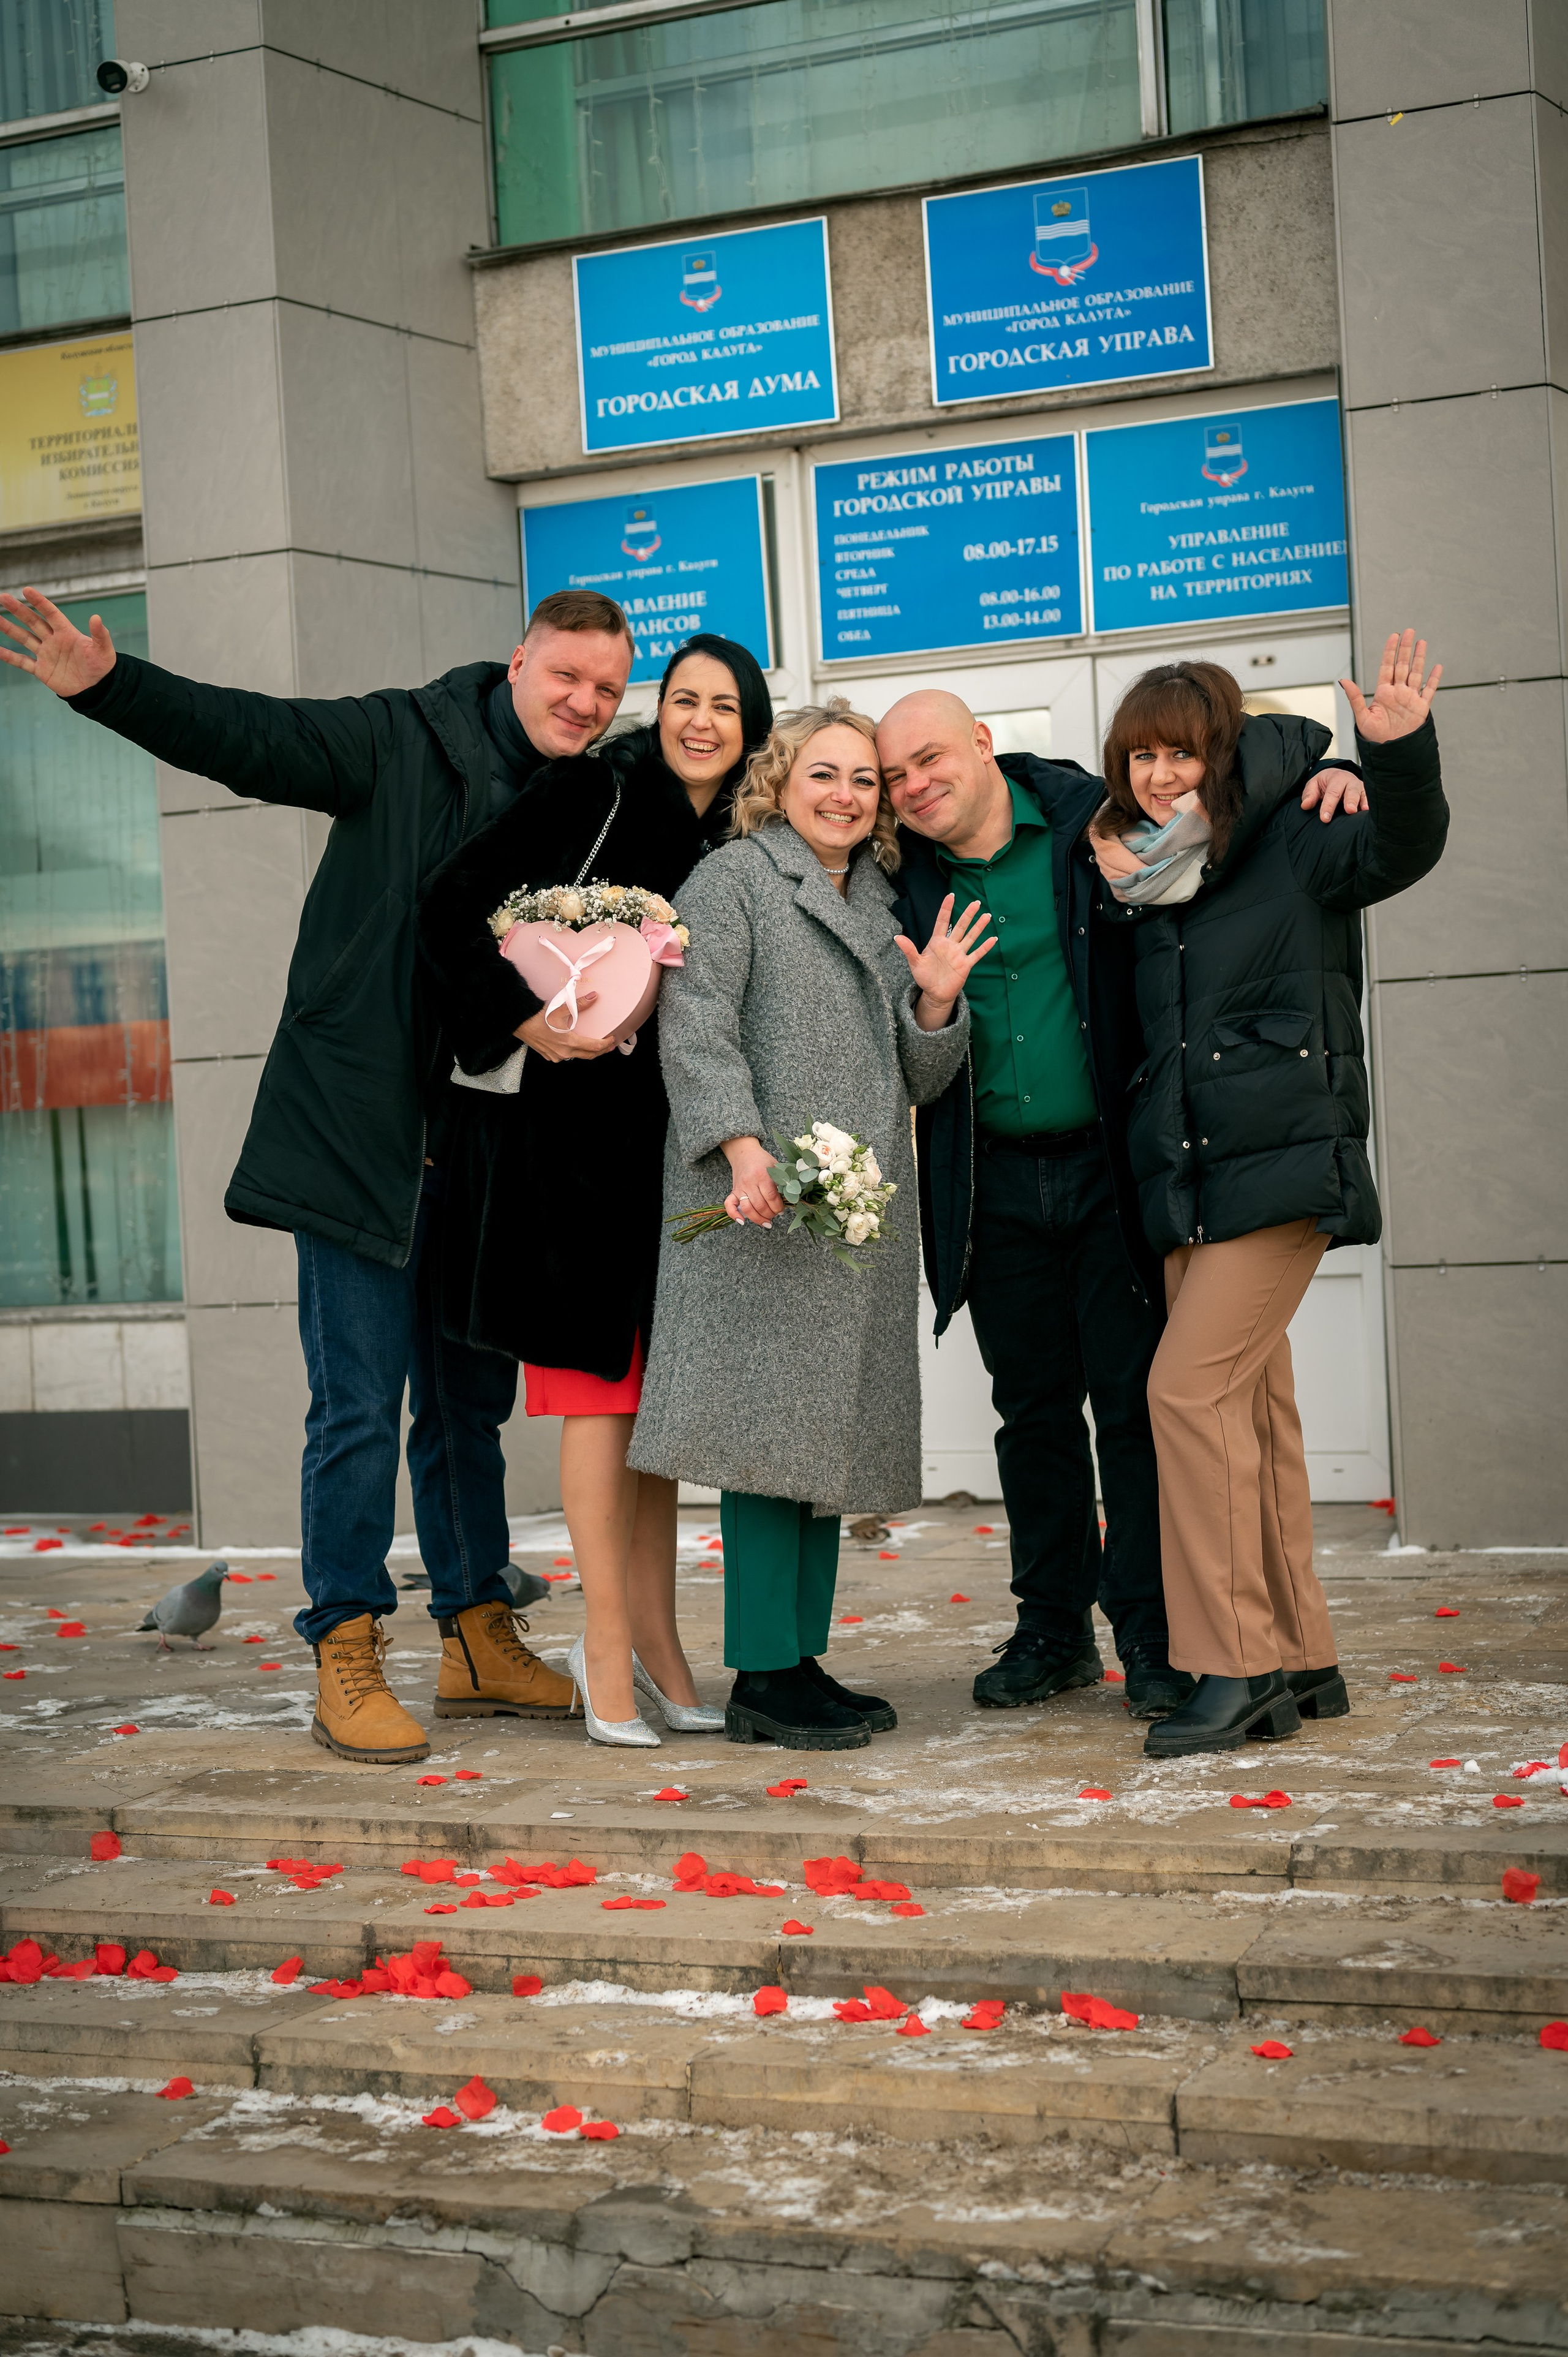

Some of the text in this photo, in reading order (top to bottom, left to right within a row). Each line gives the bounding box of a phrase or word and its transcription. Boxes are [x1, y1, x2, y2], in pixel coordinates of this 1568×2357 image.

[943, 281, 1193, 326] МУНИЦИПАЛЬНОЕ ОБРАЗОВАНИЕ
[1006, 307, 1131, 333] «ГОРОД КАЛУГА»
[590, 315, 820, 357] МУНИЦИПАЛЬНОЕ ОБРАЗОВАНИЕ
[949, 325, 1194, 374] ГОРОДСКАЯ УПРАВА
[647, 342, 763, 367] «ГОРОД КАЛУГА»
[597, 371, 820, 417] ГОРОДСКАЯ ДУМА
[858, 454, 1034, 491] РЕЖИМ РАБОТЫ
[834, 475, 1061, 517] ГОРОДСКОЙ УПРАВЫ
[1140, 499, 1203, 515] Городская
[1208, 493, 1250, 508] управа
[1269, 485, 1314, 497] Калуги
[834, 526, 929, 545] ПОНЕДЕЛЬНИК
[963, 535, 1058, 561] 08.00-17.15
[1169, 522, 1288, 549] УПРАВЛЕНИЕ
[835, 548, 894, 563] ВТОРНИК
[1104, 540, 1348, 581] ПО РАБОТЕ С НАСЕЛЕНИЕ
[835, 568, 876, 581] СРЕДА
[1151, 570, 1312, 600] НА ТЕРРИТОРИЯХ
[619, 591, 707, 615] АВЛЕНИЕ
[837, 584, 888, 598] ЧЕТВЕРГ
[837, 586, 1060, 620] ПЯТНИЦА 08.00-16.00
[838, 609, 1061, 642] ОБЕД 13.00-14.00
